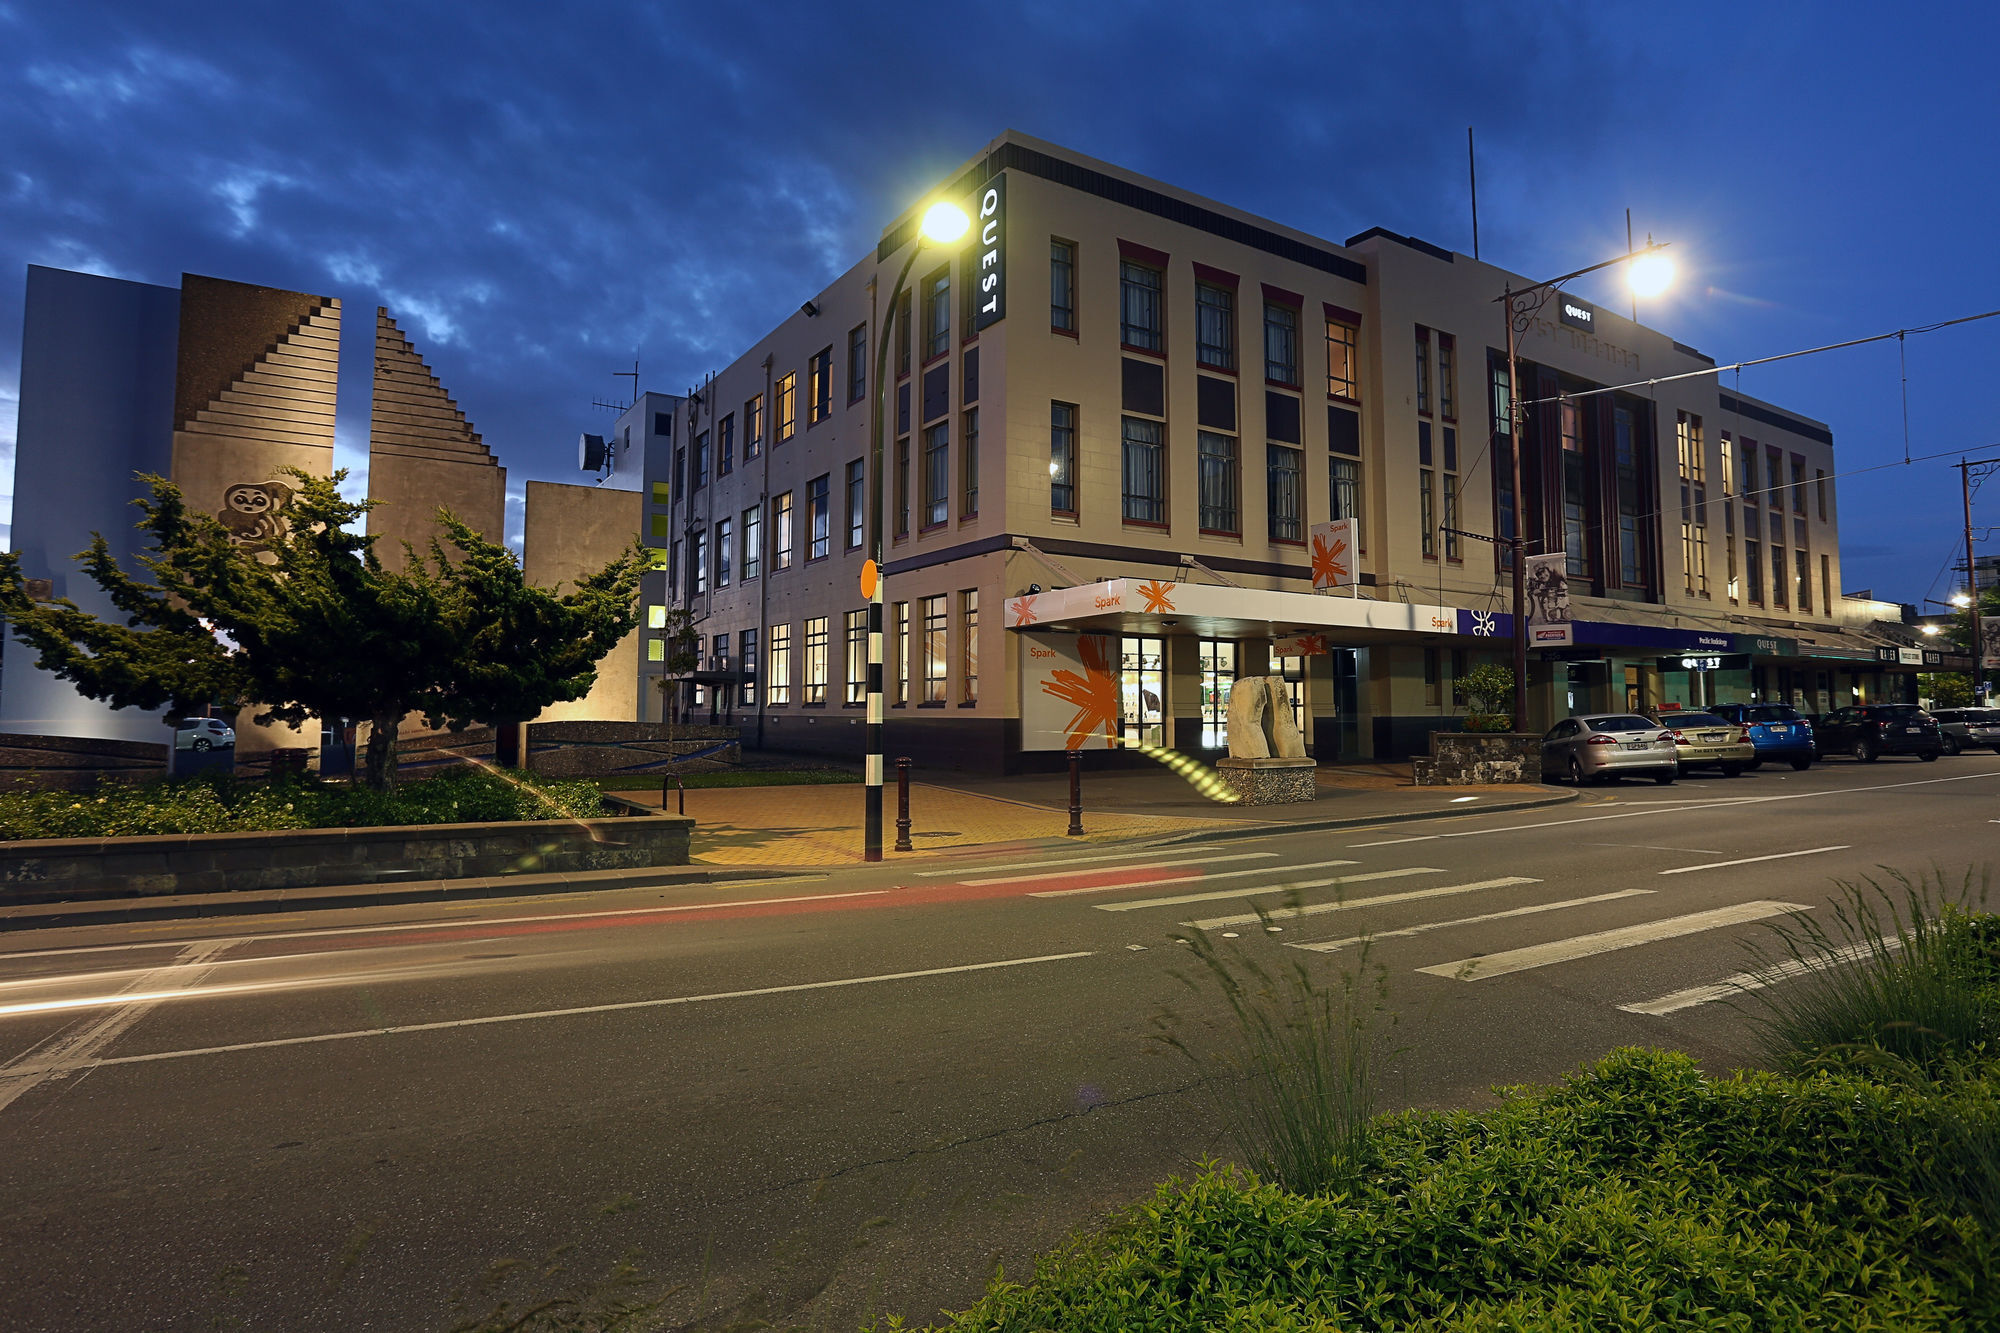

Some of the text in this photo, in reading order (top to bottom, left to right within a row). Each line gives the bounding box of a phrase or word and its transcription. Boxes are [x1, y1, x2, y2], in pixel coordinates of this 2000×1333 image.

[979, 188, 998, 313] QUEST
[1565, 304, 1591, 322] QUEST
[1329, 522, 1348, 533] Spark
[1095, 594, 1121, 610] Spark
[1431, 616, 1452, 629] Spark
[1275, 645, 1293, 655] Spark
[1756, 639, 1777, 649] QUEST
[1030, 647, 1056, 659] Spark
[1681, 657, 1721, 669] QUST
